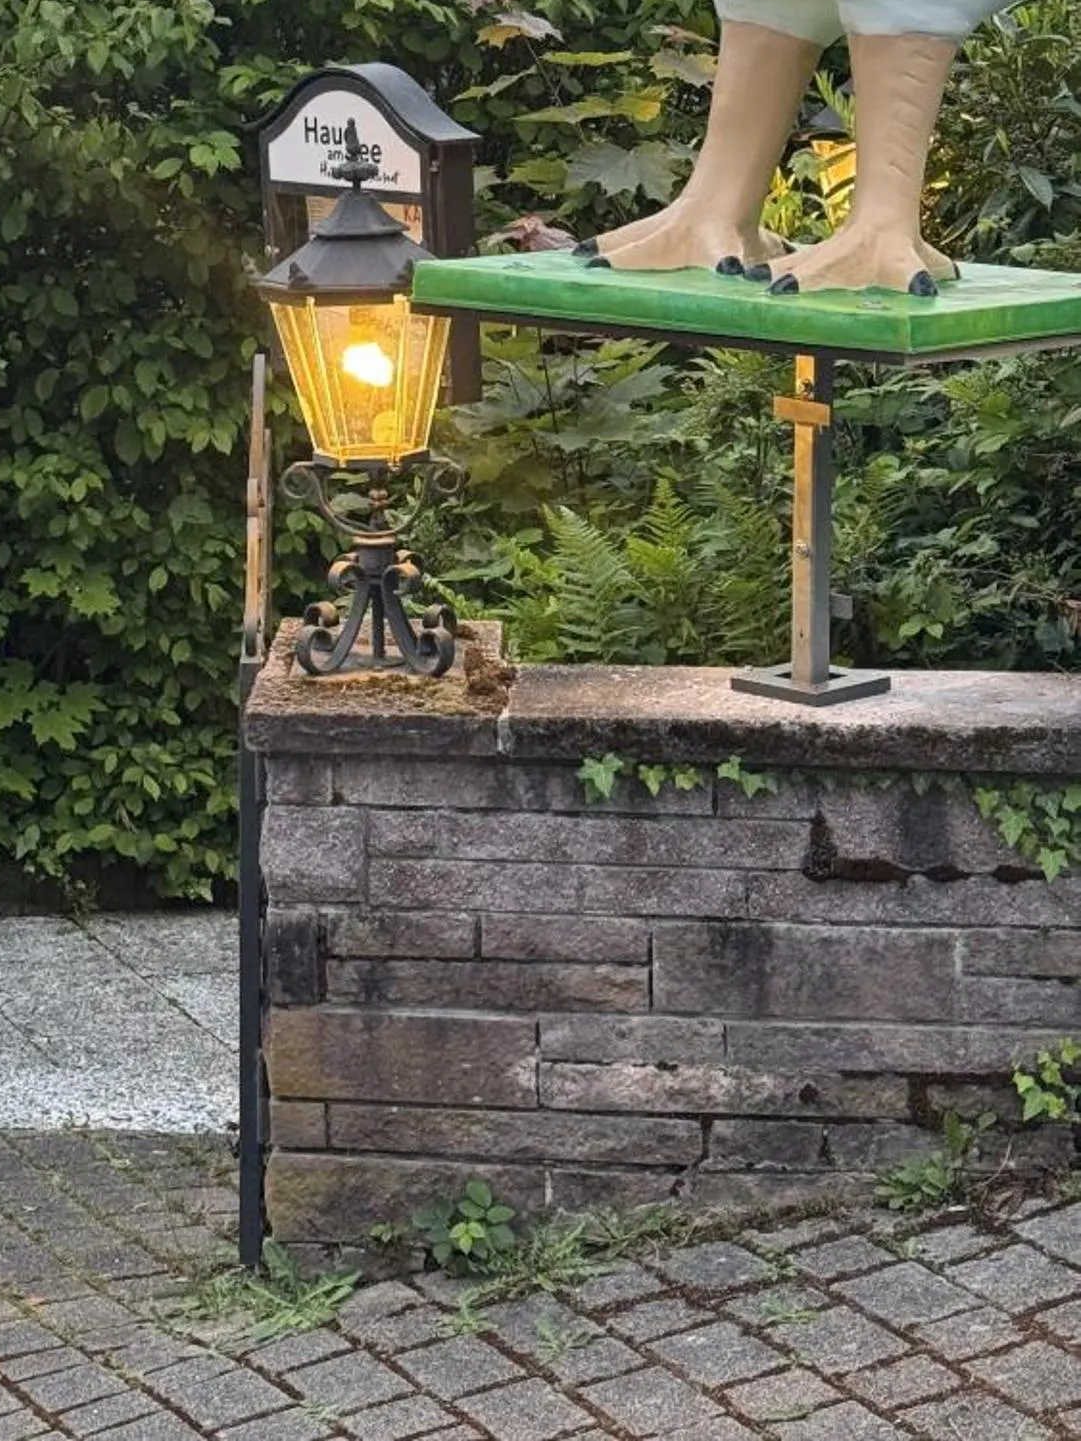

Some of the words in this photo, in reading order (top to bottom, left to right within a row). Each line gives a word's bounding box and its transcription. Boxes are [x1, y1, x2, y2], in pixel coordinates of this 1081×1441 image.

[304, 117, 345, 146] Hau
[327, 149, 344, 161] am
[345, 144, 382, 163] ee
